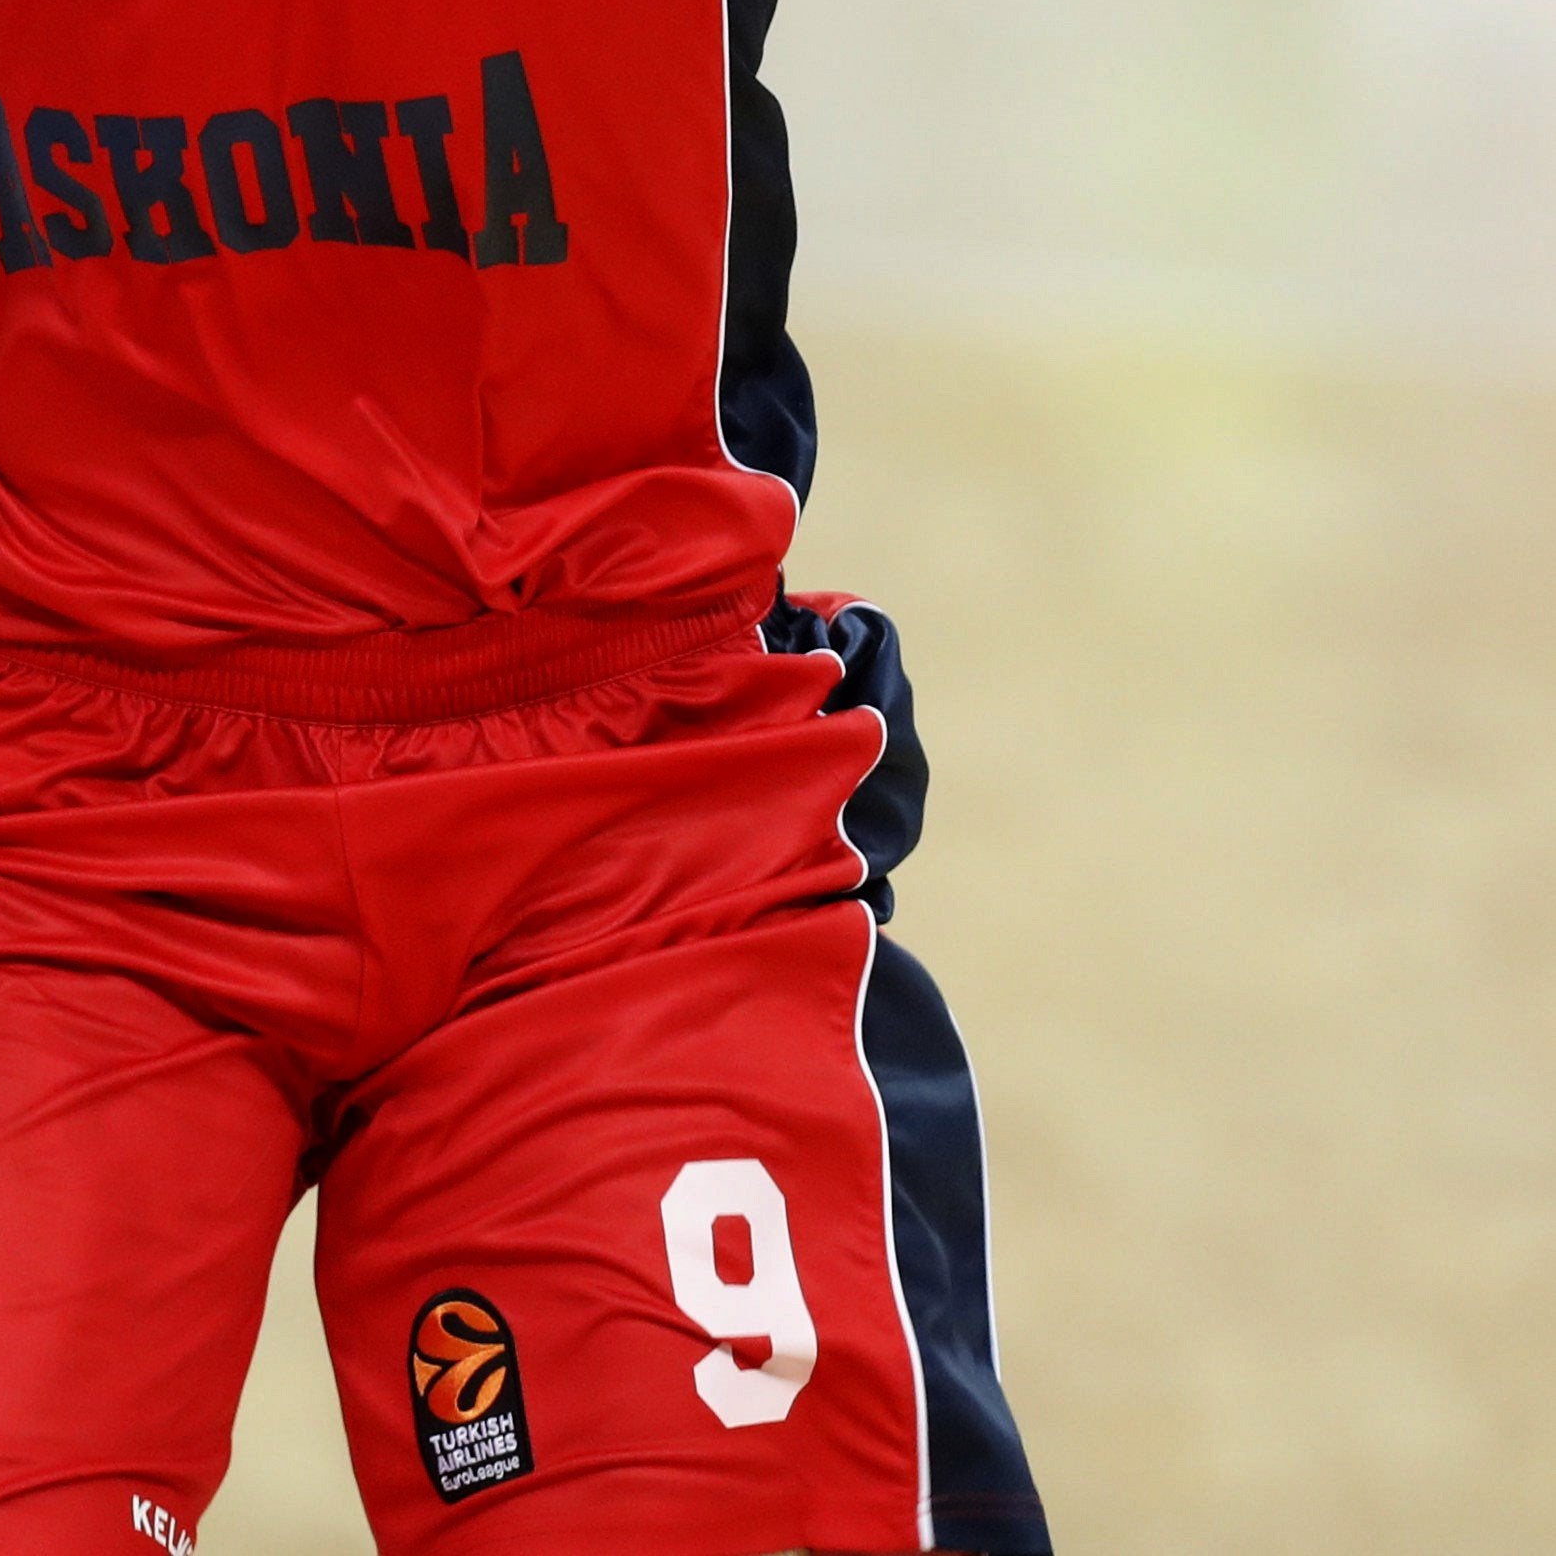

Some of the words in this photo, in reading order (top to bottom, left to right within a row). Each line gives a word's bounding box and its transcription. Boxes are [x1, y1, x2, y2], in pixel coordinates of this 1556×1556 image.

[660, 1158, 819, 1429] 9
[429, 1412, 515, 1454] TURKISH
[438, 1433, 518, 1475] AIRLINES
[440, 1455, 520, 1492] EuroLeague
